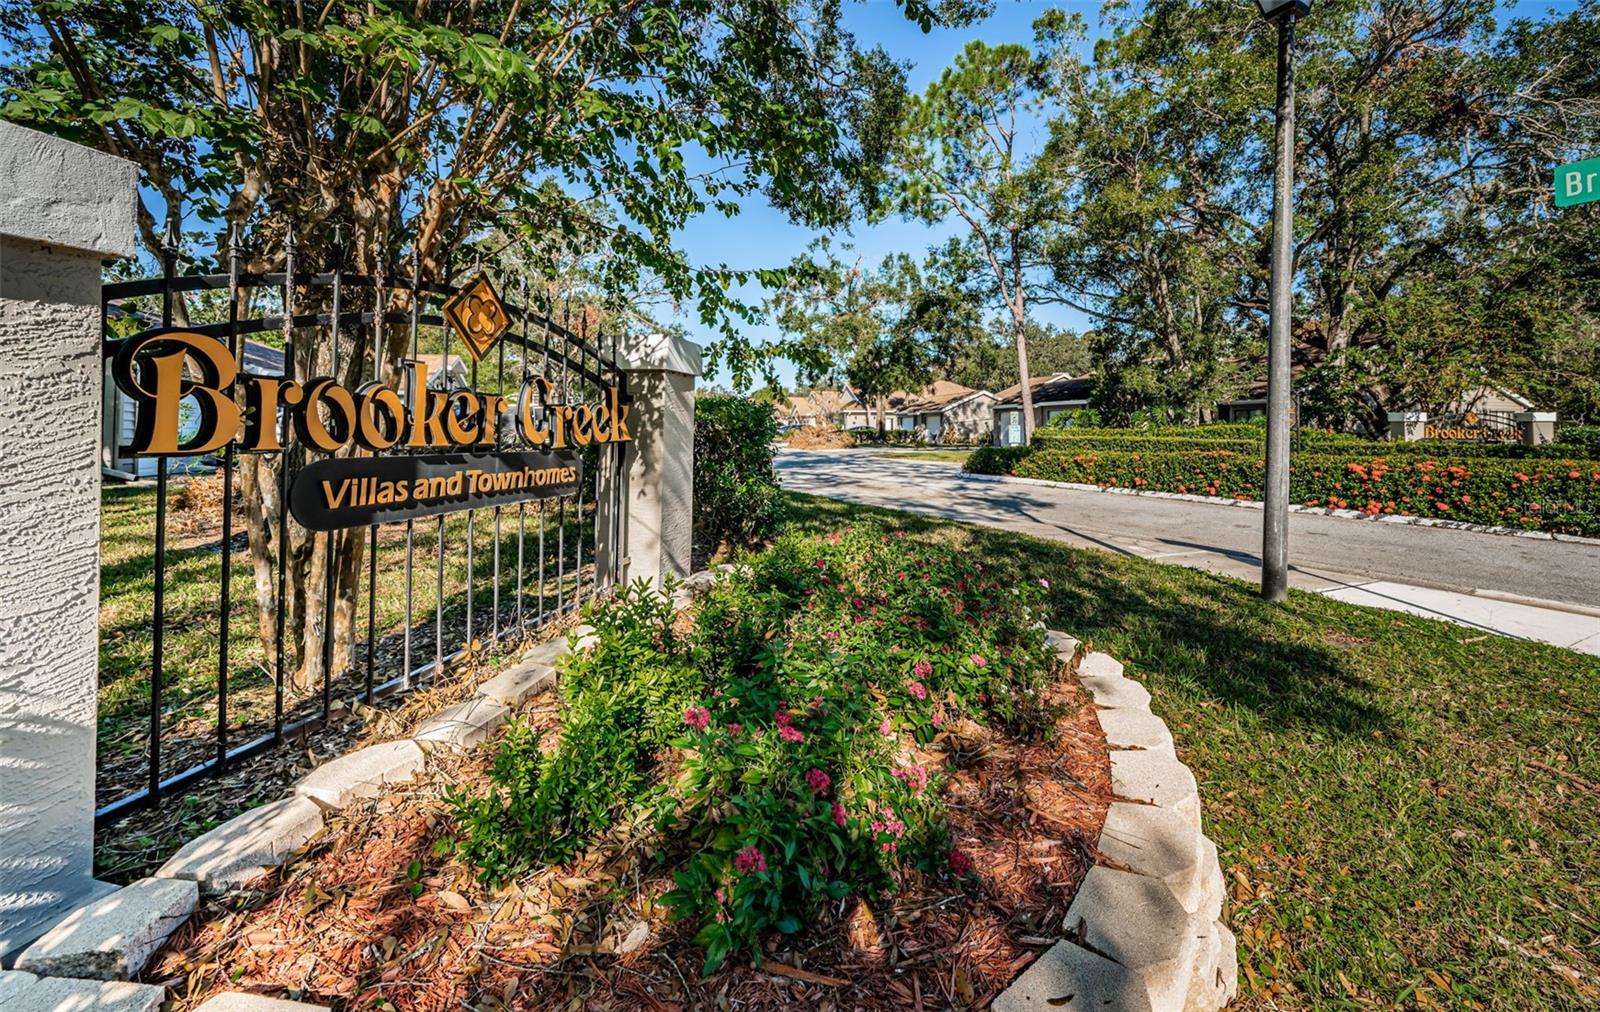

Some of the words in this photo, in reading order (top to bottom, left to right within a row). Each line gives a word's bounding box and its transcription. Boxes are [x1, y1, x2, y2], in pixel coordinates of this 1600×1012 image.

[128, 331, 509, 454] Brooker
[521, 376, 633, 448] Creek
[1424, 424, 1481, 439] Brooker
[322, 477, 408, 509] Villas
[413, 470, 463, 500] and
[466, 466, 576, 494] Townhomes
